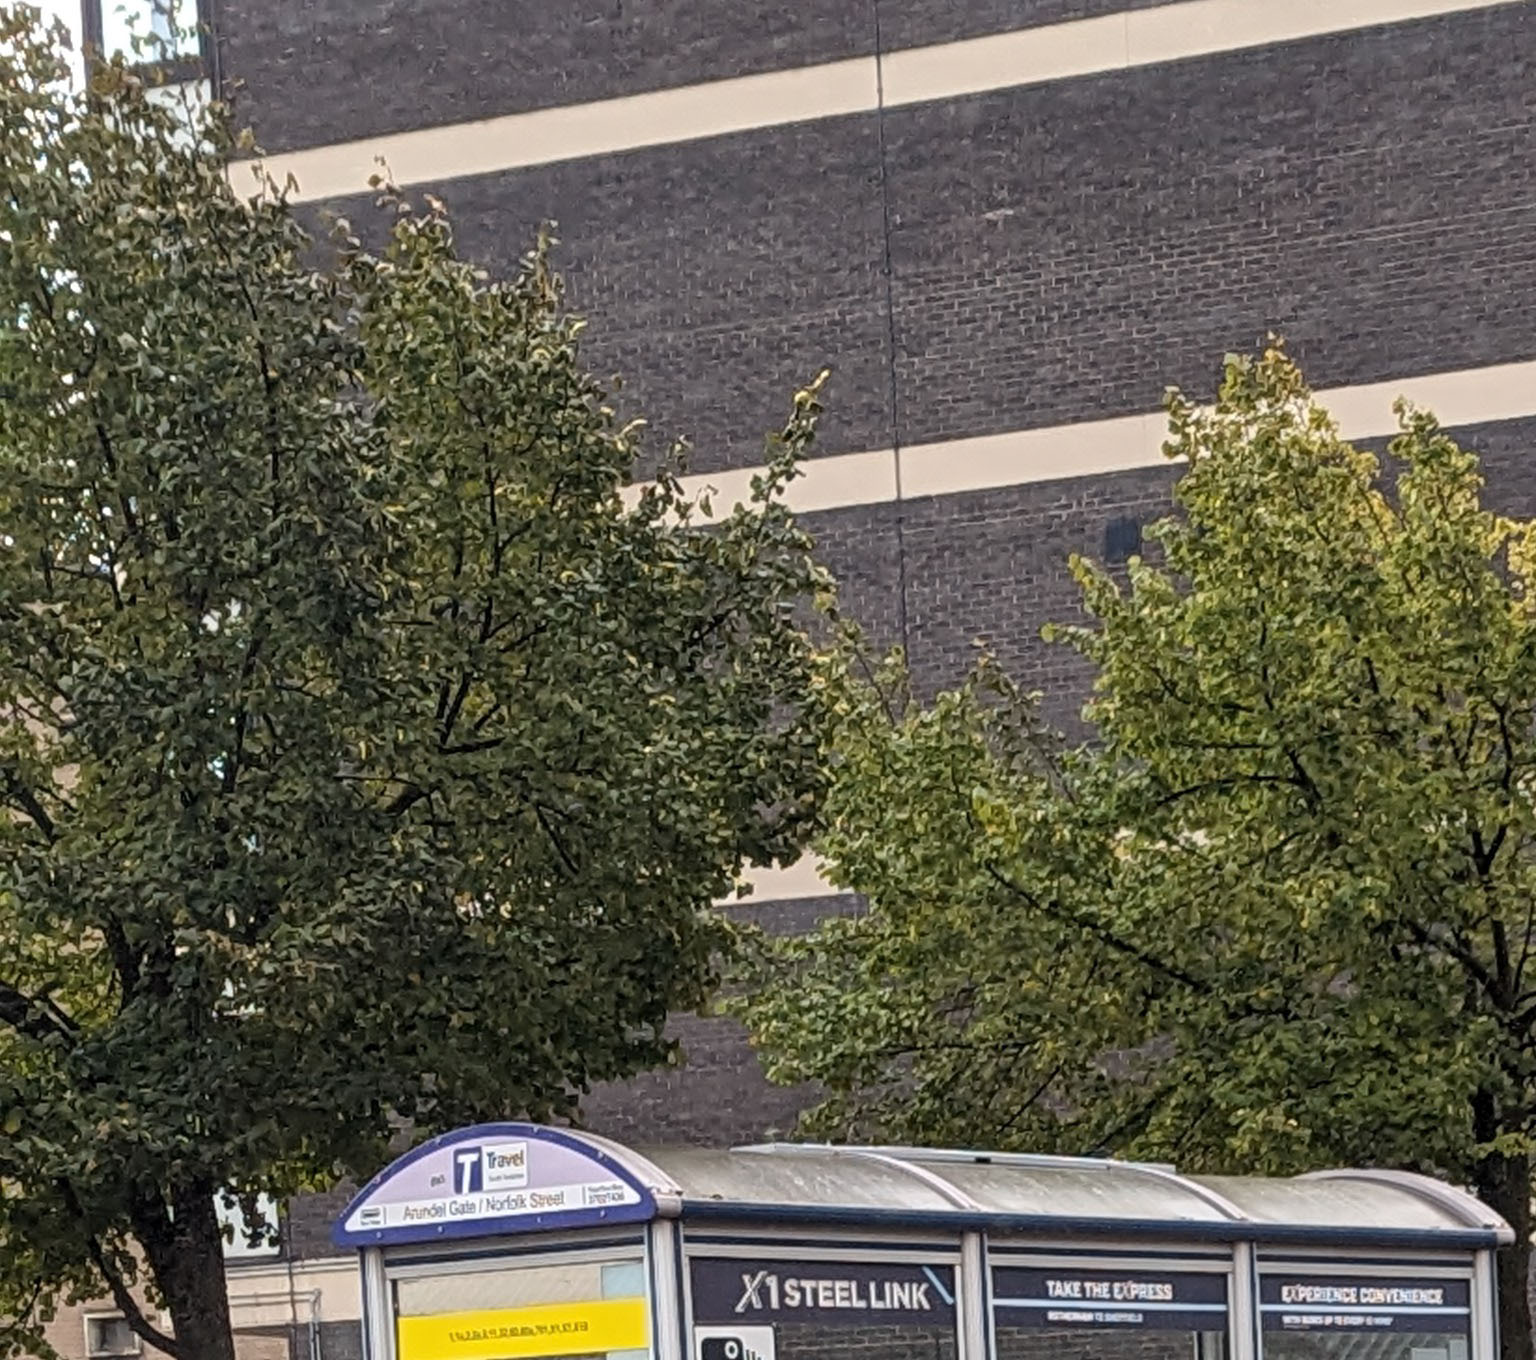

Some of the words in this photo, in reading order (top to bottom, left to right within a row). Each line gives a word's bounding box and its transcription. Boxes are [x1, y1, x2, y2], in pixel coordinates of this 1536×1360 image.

[487, 1150, 525, 1170] Travel
[403, 1202, 446, 1221] Arundel
[449, 1199, 476, 1216] Gate
[486, 1196, 527, 1213] Norfolk
[530, 1191, 565, 1209] Street
[734, 1271, 780, 1313] X1
[784, 1278, 868, 1308] STEEL
[869, 1281, 932, 1311] LINK
[1046, 1280, 1082, 1298] TAKE
[1084, 1281, 1111, 1299] THE
[1113, 1280, 1174, 1300] EXPRESS
[1281, 1284, 1358, 1303] EXPERIENCE
